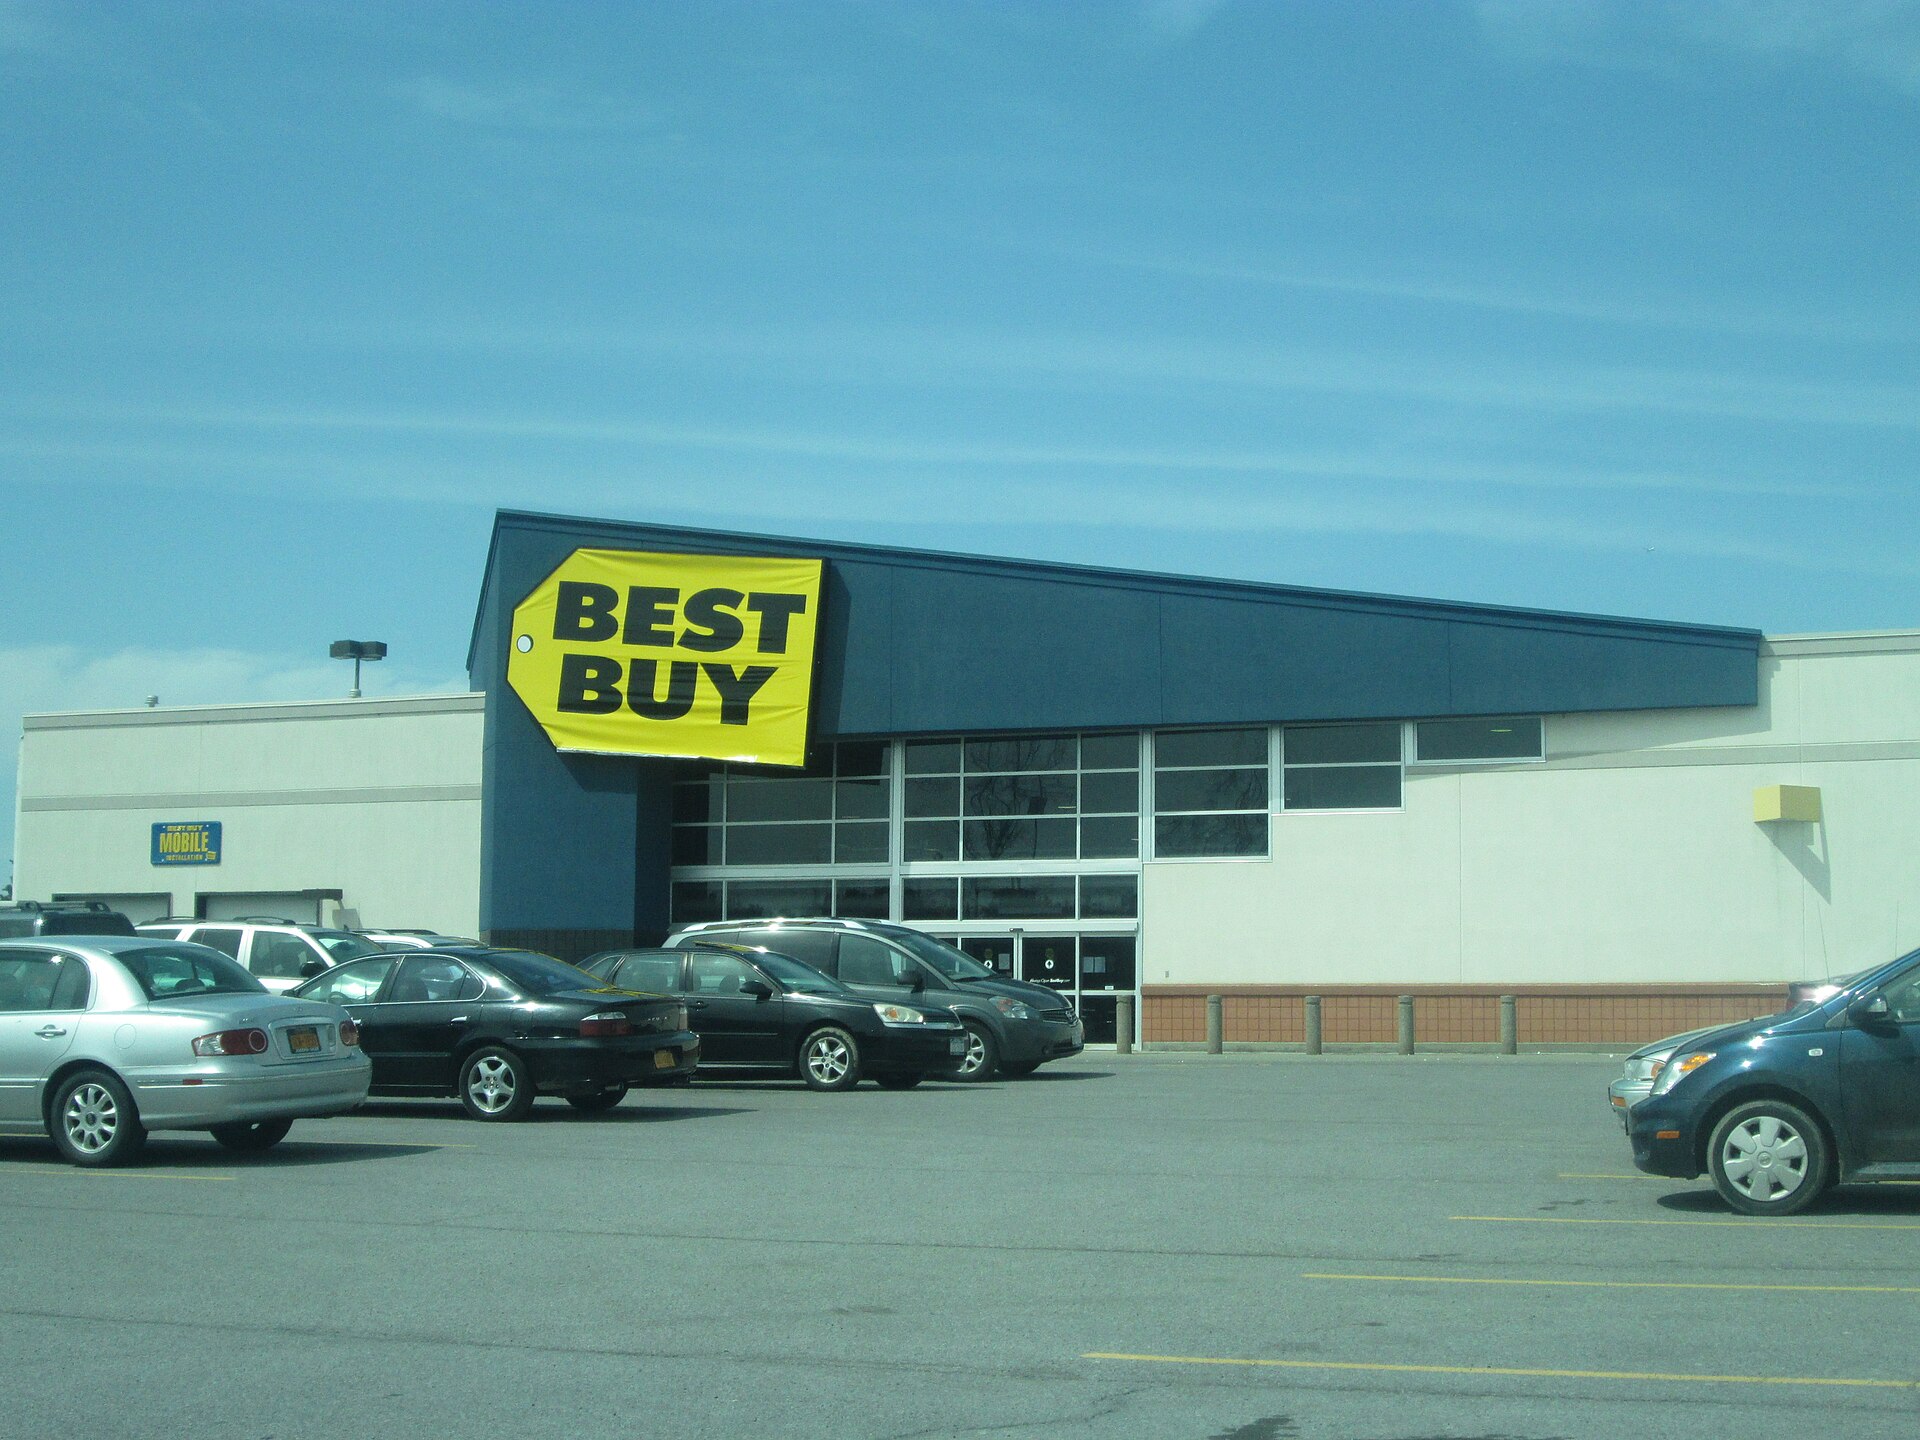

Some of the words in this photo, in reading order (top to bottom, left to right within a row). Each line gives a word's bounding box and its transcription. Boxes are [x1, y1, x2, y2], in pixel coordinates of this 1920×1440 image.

[553, 581, 807, 654] BEST
[557, 653, 779, 726] BUY
[160, 832, 209, 853] MOBILE
